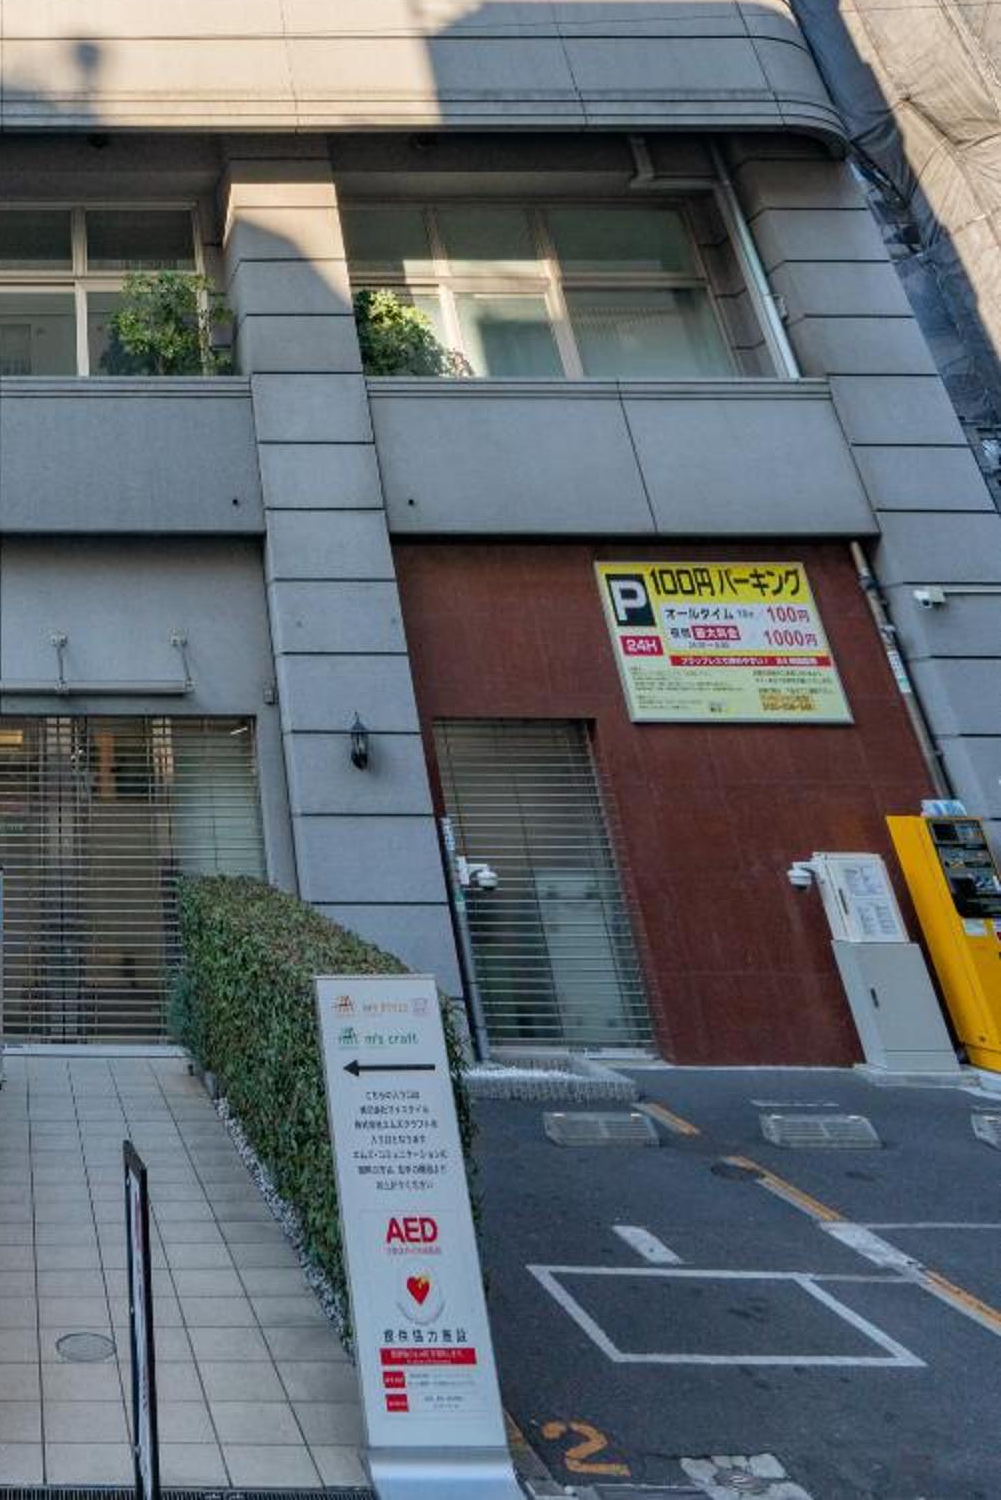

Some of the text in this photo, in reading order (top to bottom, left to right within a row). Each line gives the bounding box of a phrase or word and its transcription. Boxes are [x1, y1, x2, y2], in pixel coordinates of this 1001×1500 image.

[650, 567, 801, 598] 100円パーキング
[609, 579, 649, 622] P
[665, 607, 735, 621] オールタイム
[766, 605, 810, 623] 100円
[625, 640, 658, 653] 24H
[764, 629, 818, 648] 1000円
[386, 1217, 439, 1244] AED
[542, 1420, 631, 1477] 2
